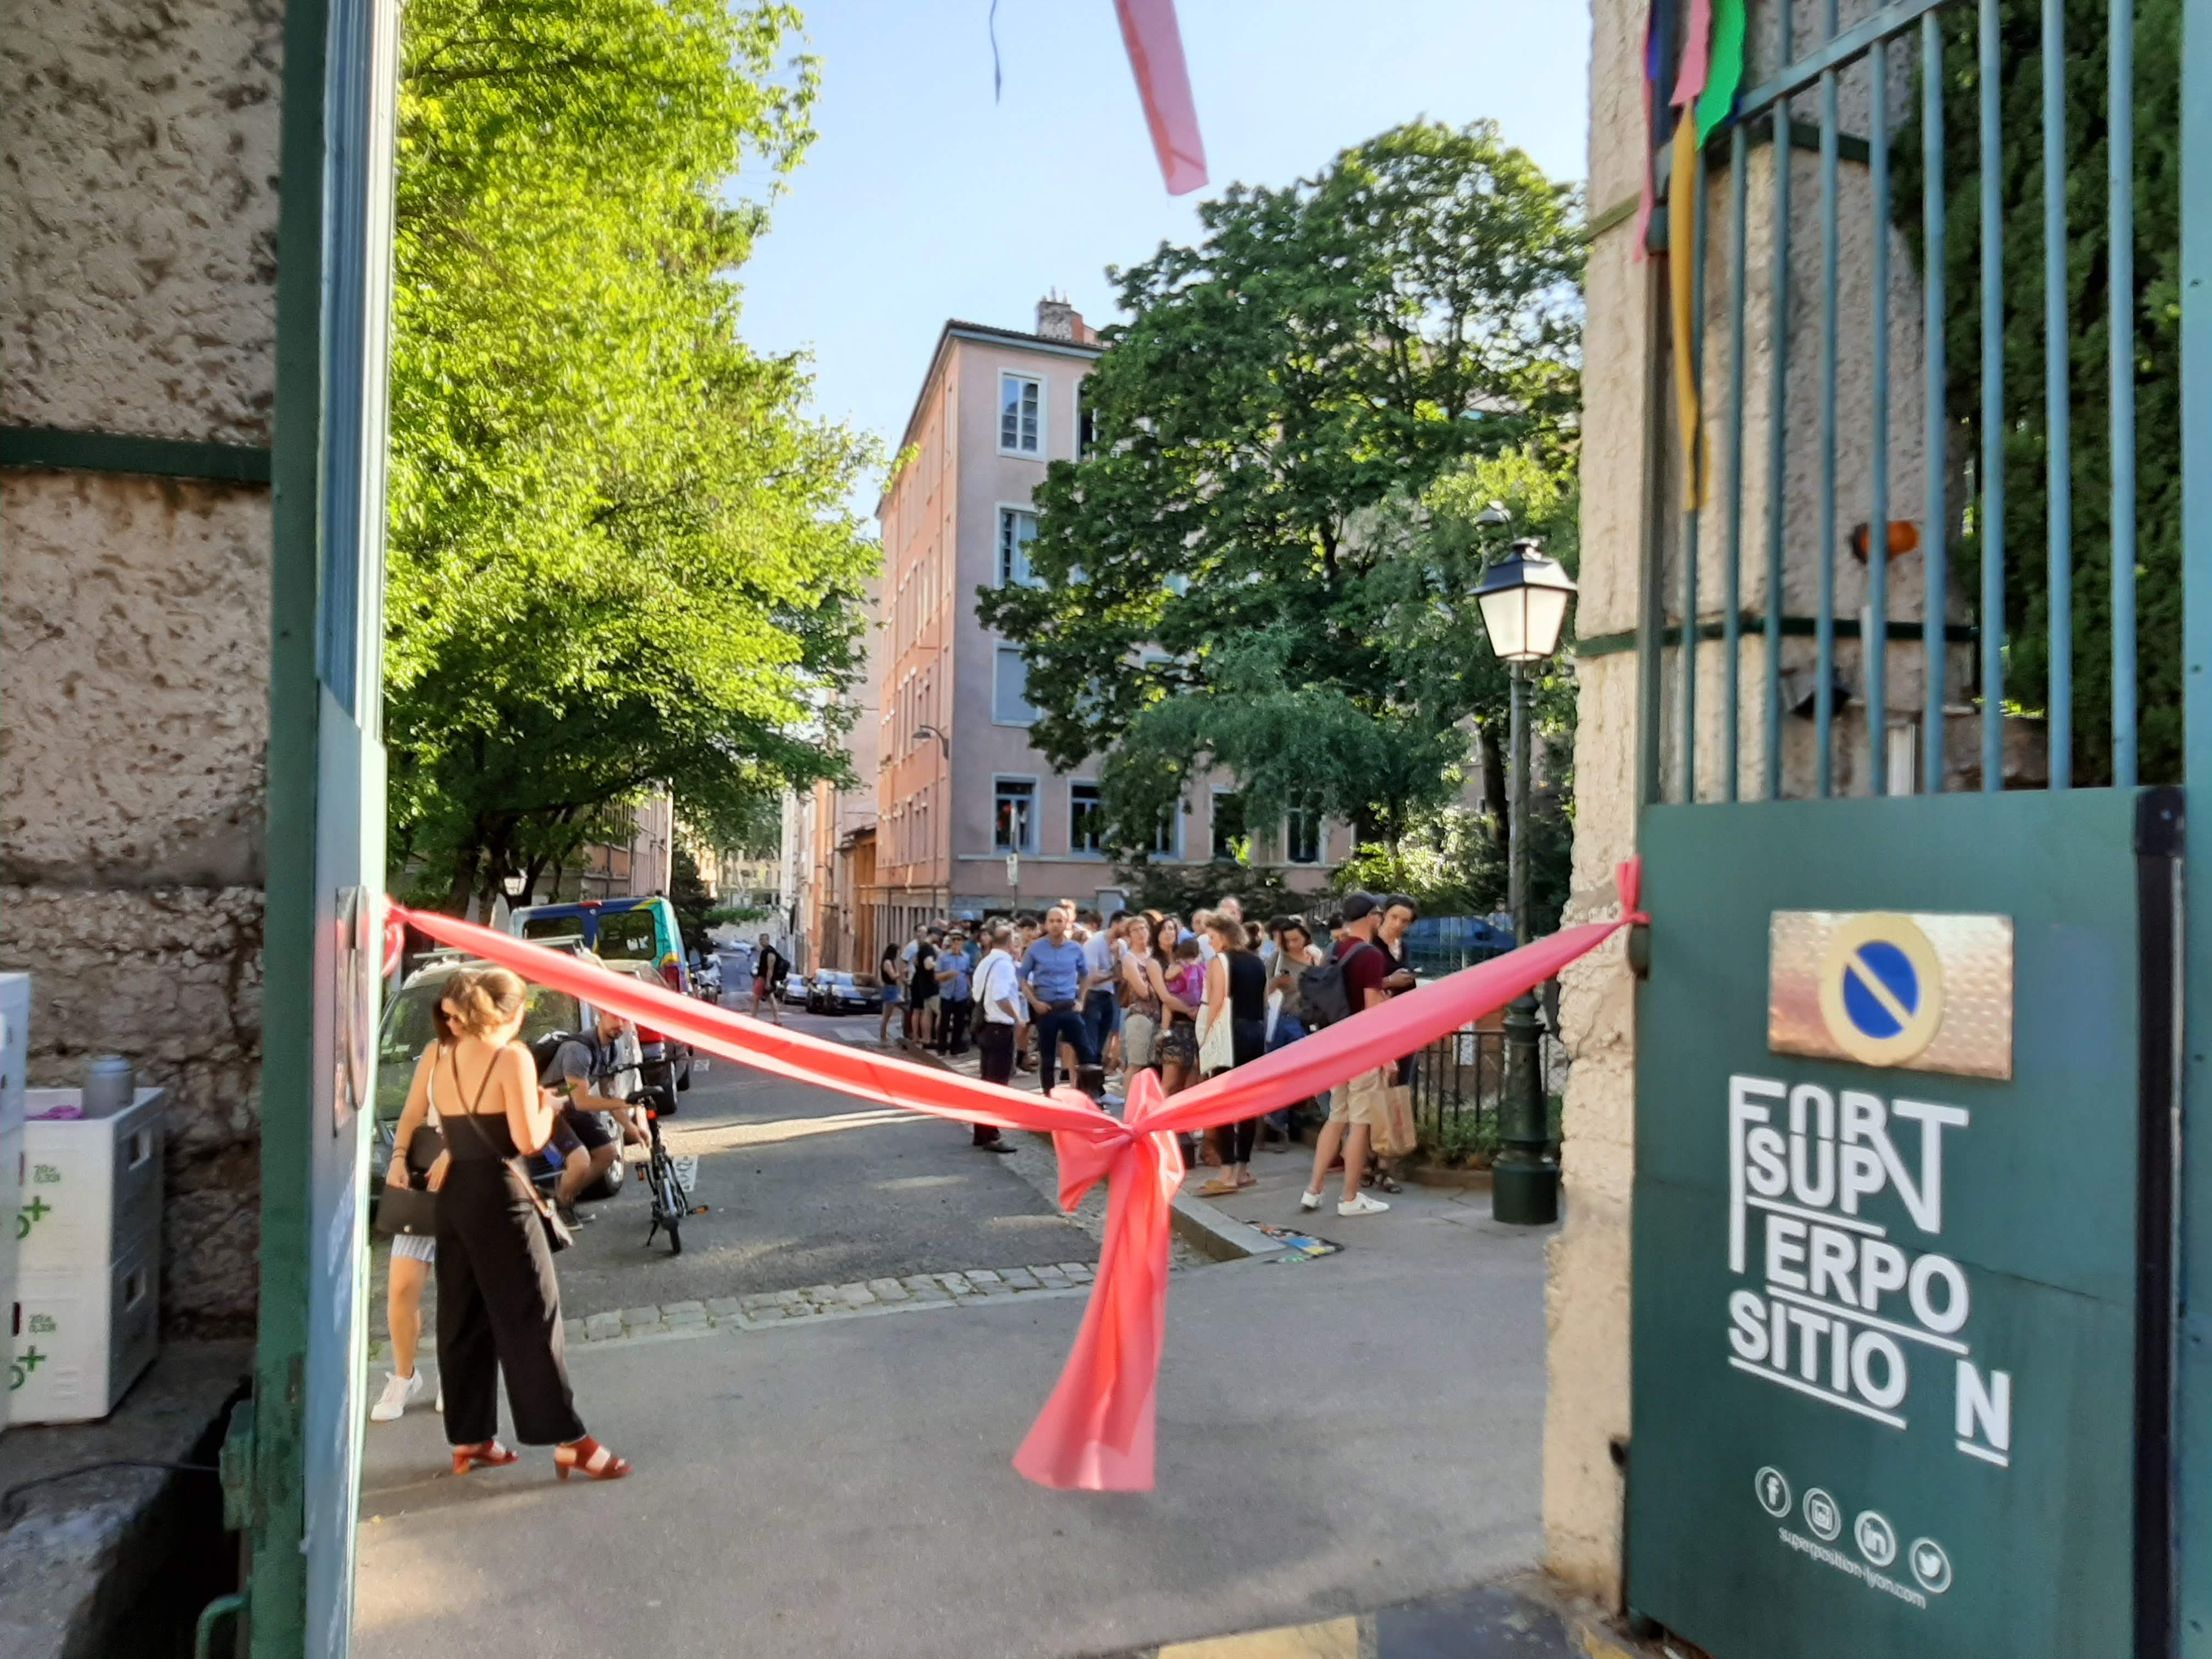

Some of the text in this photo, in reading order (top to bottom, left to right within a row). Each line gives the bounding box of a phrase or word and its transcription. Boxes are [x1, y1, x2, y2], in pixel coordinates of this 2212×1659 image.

[1729, 1075, 1970, 1274] FORT
[1746, 1127, 1887, 1215] SUP
[1766, 1214, 1970, 1334] ERPO
[1728, 1290, 2010, 1452] SITIO N
